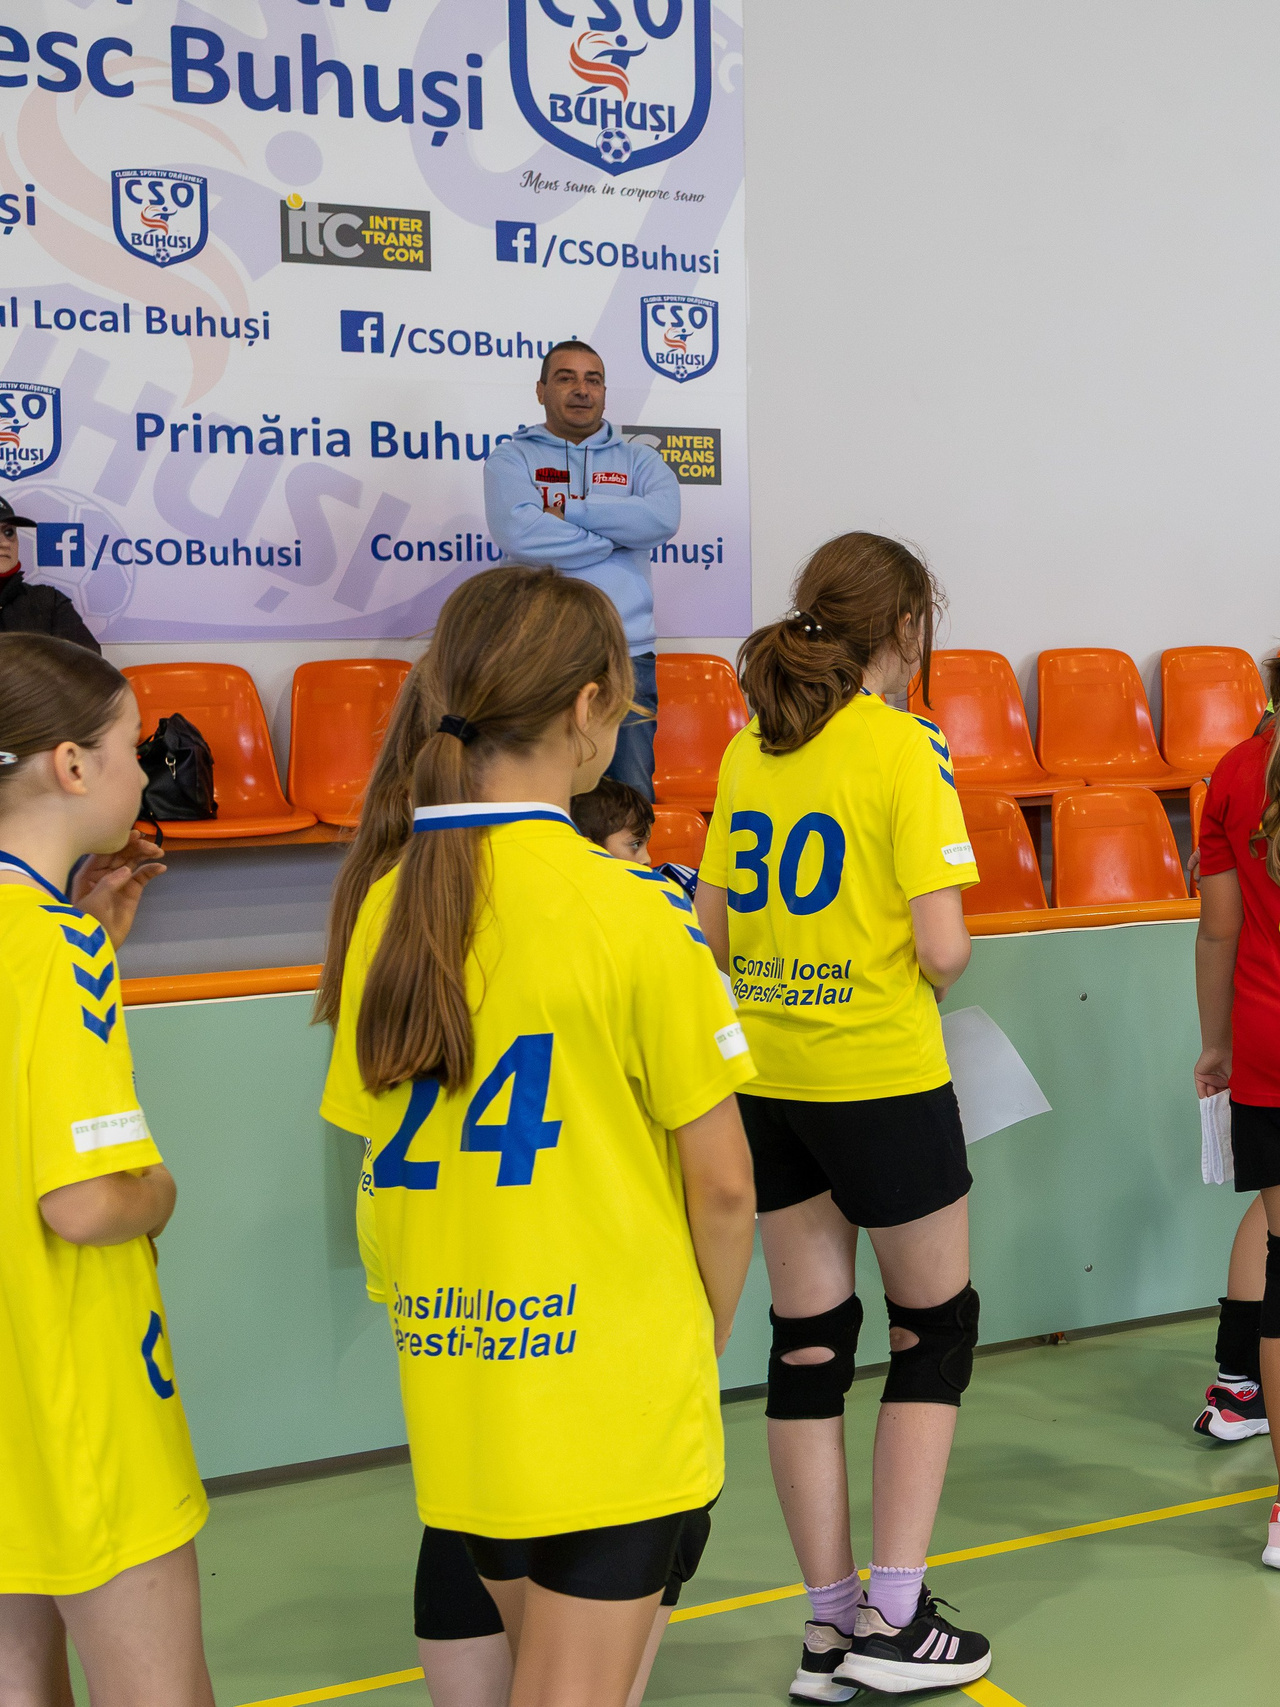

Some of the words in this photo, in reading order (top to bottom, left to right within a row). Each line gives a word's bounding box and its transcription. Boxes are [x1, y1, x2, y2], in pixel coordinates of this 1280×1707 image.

[170, 25, 484, 147] Buhuși
[548, 93, 676, 140] BUHUȘI
[124, 179, 194, 208] CSO
[519, 170, 560, 194] Mens
[563, 181, 597, 195] sana
[601, 183, 616, 196] in
[620, 187, 671, 203] corpore
[673, 190, 707, 203] sano
[286, 193, 364, 259] itc
[361, 230, 424, 248] TRANS
[369, 215, 423, 233] INTER
[130, 232, 192, 252] BUHUȘI
[383, 247, 424, 264] COM
[541, 234, 720, 274] /CSOBuhusi
[34, 299, 131, 333] Local
[145, 305, 271, 347] Buhuși
[651, 304, 708, 330] CSO
[655, 353, 705, 369] BUHUȘI
[135, 412, 351, 458] Primăria
[666, 435, 715, 450] INTER
[660, 449, 715, 464] TRANS
[678, 464, 716, 478] COM
[91, 533, 302, 571] /CSOBuhusi
[370, 532, 503, 562] Consiliu
[727, 810, 846, 916] 30
[790, 958, 852, 981] local
[372, 1032, 563, 1190] 24
[486, 1283, 577, 1323] local
